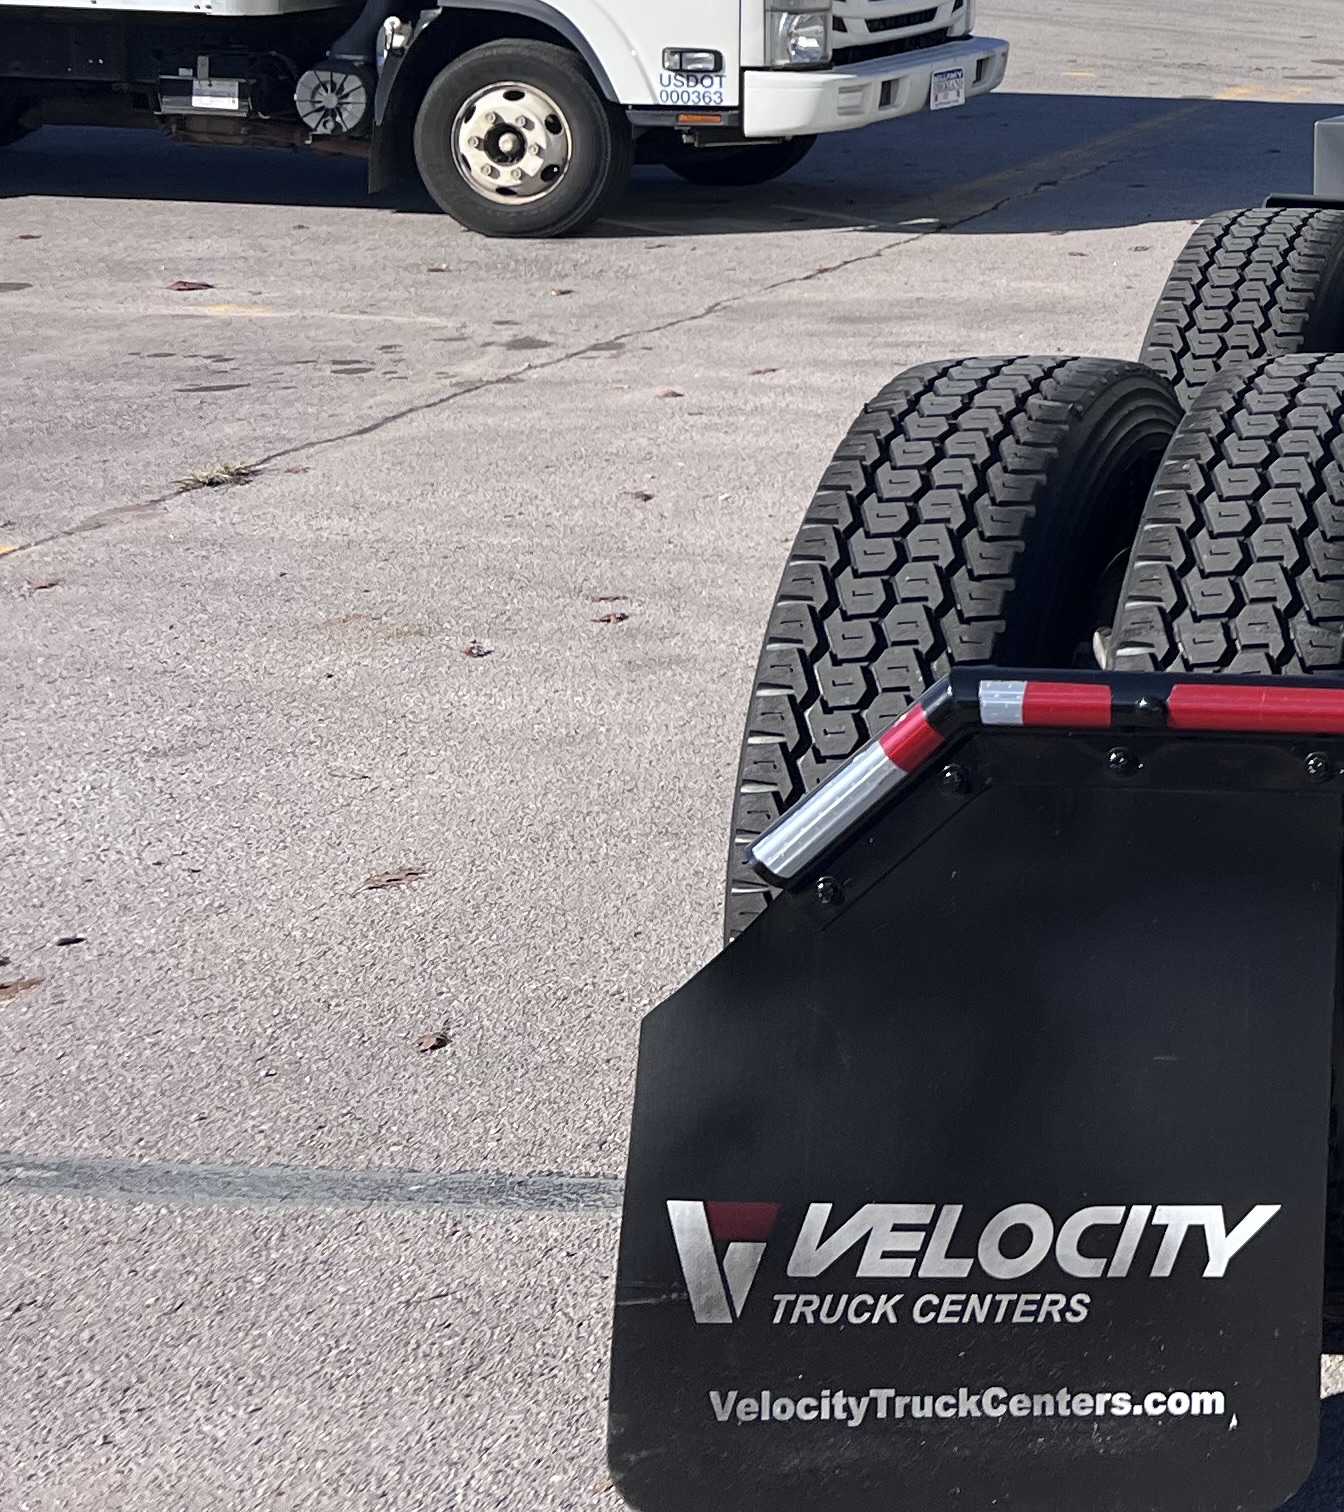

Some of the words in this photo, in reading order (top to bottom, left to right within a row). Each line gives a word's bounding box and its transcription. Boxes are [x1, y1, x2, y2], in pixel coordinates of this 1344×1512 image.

[660, 73, 726, 88] USDOT
[660, 90, 723, 104] 000363
[786, 1202, 1282, 1279] VELOCITY
[771, 1294, 903, 1324] TRUCK
[912, 1293, 1091, 1325] CENTERS
[708, 1388, 1225, 1428] VelocityTruckCenters.com
